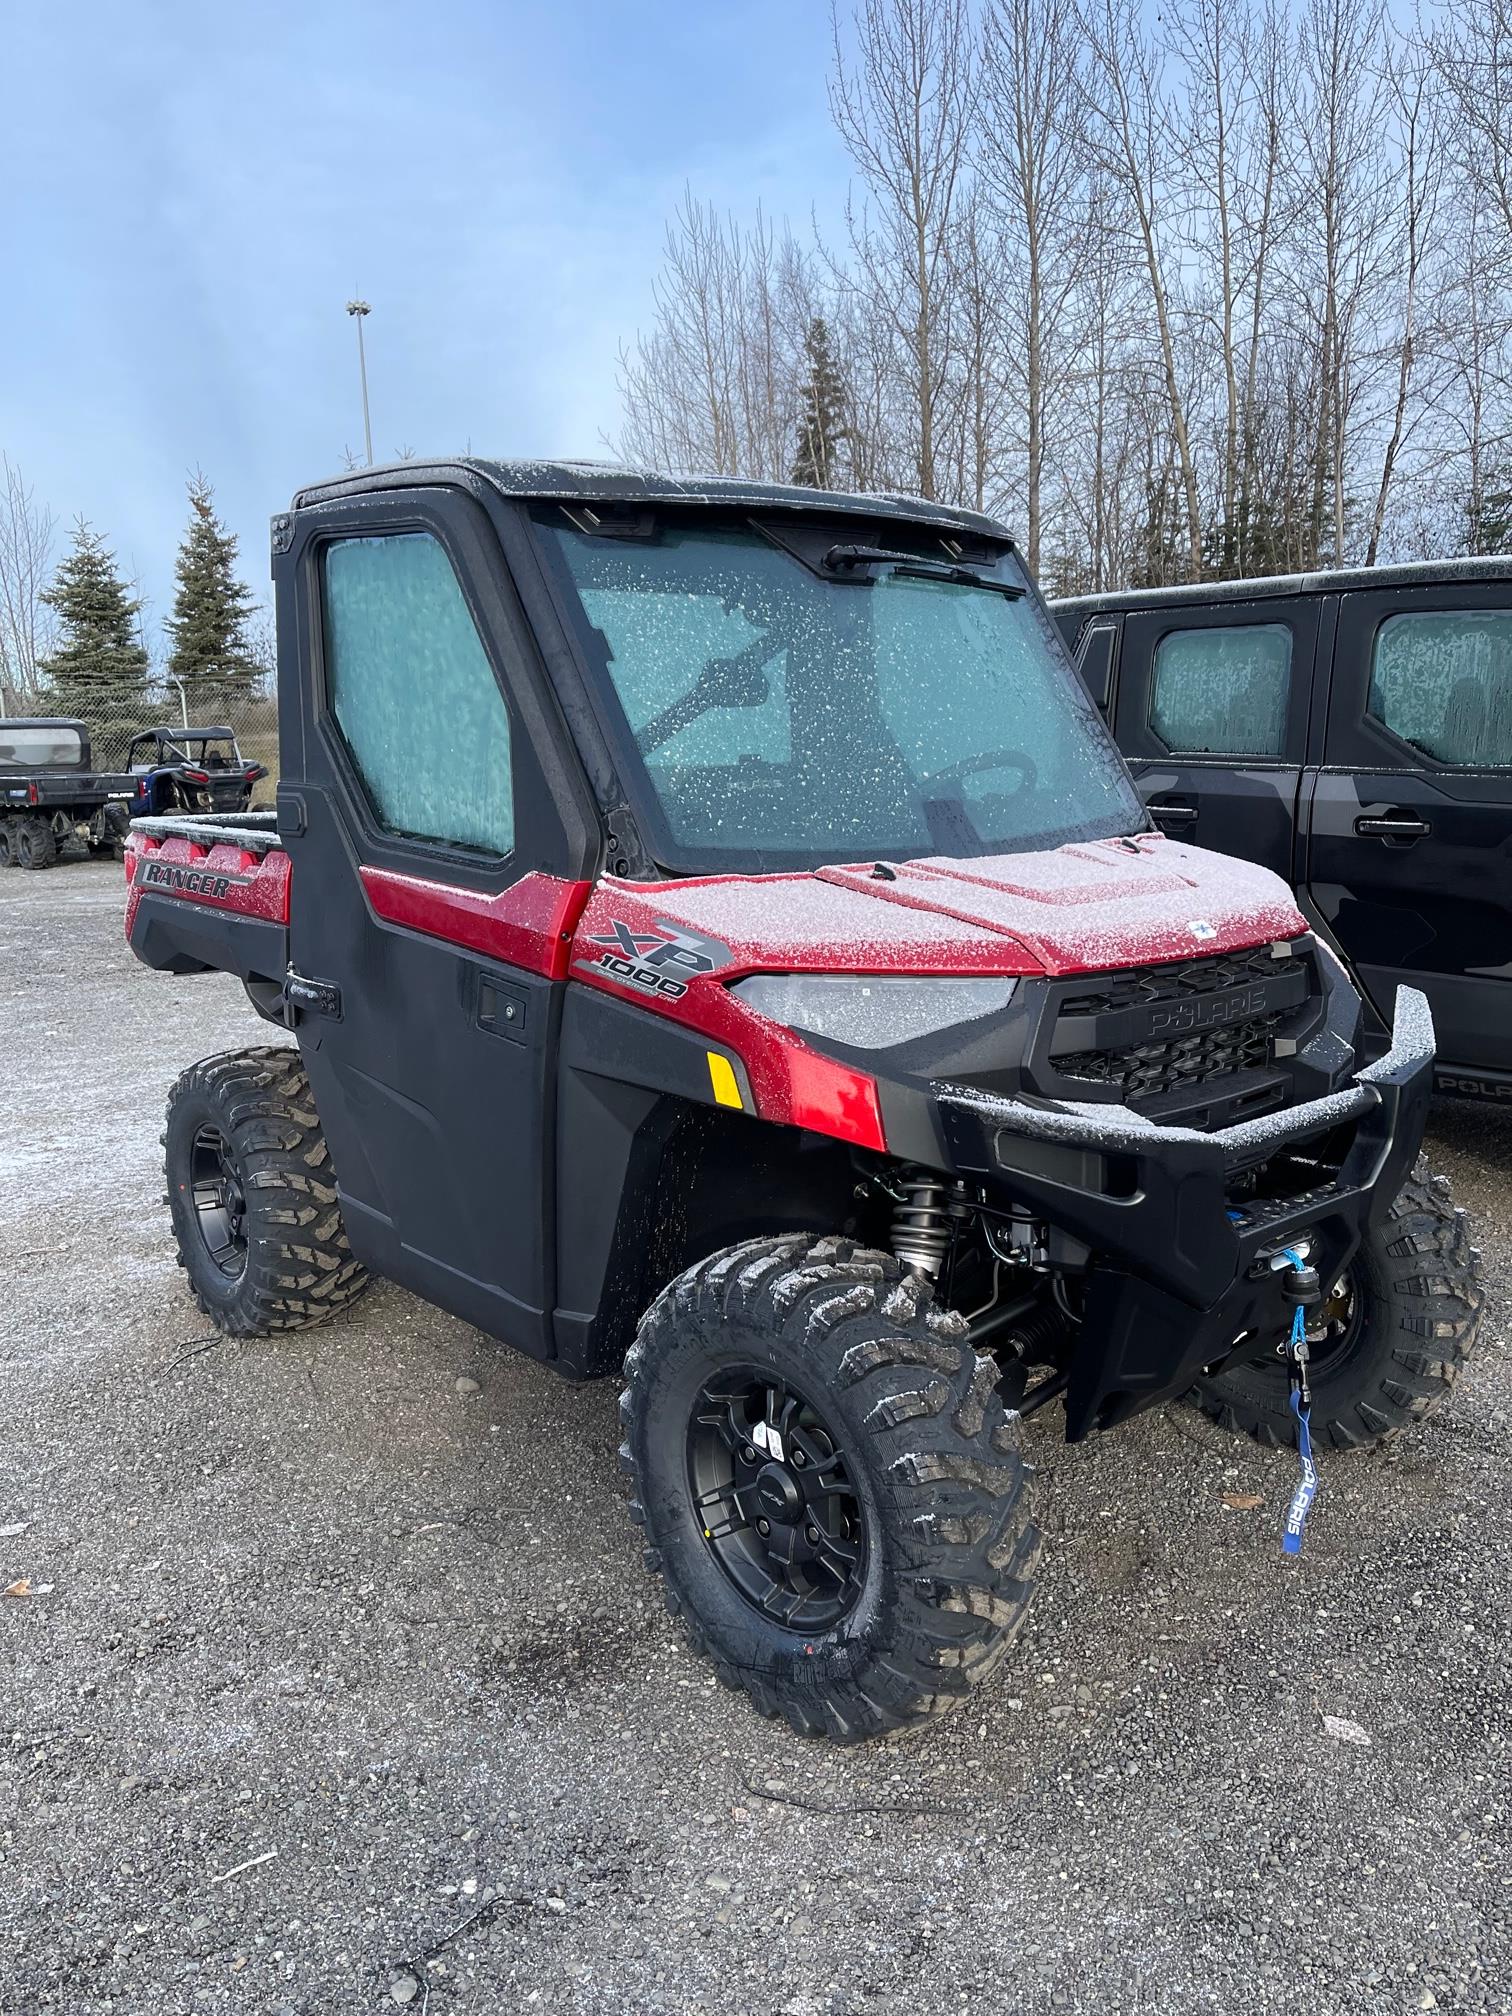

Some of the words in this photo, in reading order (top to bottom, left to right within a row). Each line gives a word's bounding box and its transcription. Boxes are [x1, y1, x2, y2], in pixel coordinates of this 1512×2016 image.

[145, 862, 231, 900] RANGER
[584, 919, 715, 974] XP
[596, 968, 616, 980] DUAL
[617, 976, 659, 996] OVERHEAD
[658, 991, 678, 1005] CAM
[600, 953, 689, 999] 1000
[1147, 985, 1267, 1036] POLARIS
[1287, 1455, 1316, 1536] POLARIS
